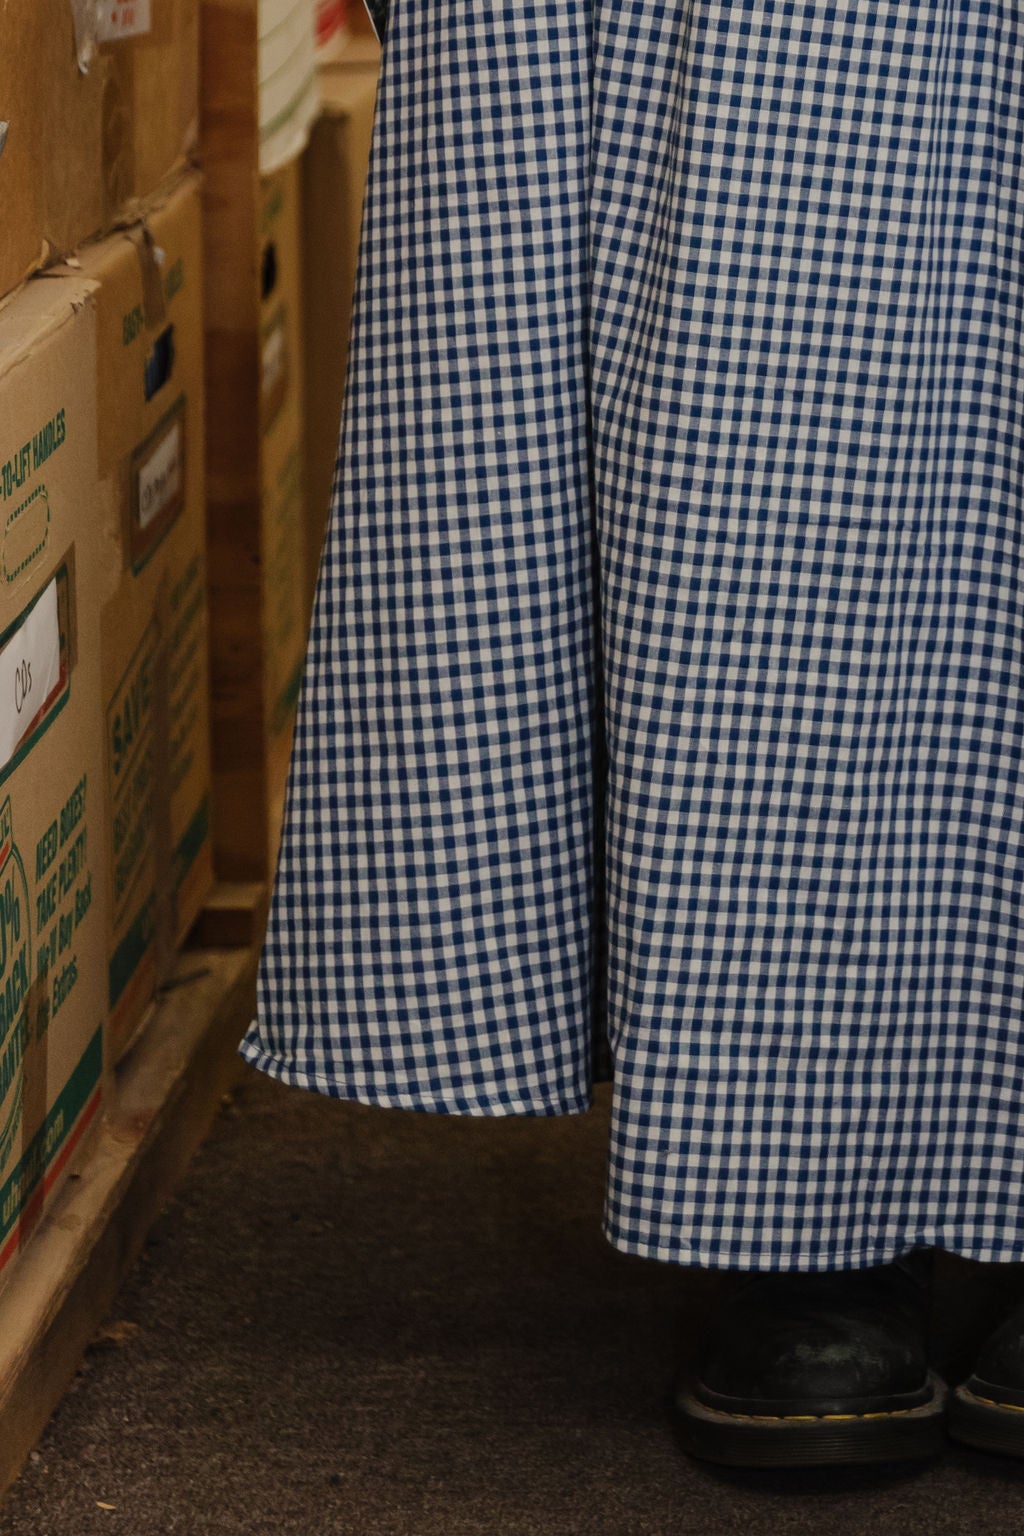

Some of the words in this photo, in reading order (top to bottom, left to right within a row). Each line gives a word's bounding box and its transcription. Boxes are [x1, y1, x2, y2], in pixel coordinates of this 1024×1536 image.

[33, 408, 66, 472] HANDLES
[15, 658, 33, 715] CDs
[35, 817, 58, 884] NEED
[36, 871, 58, 936] TAKE
